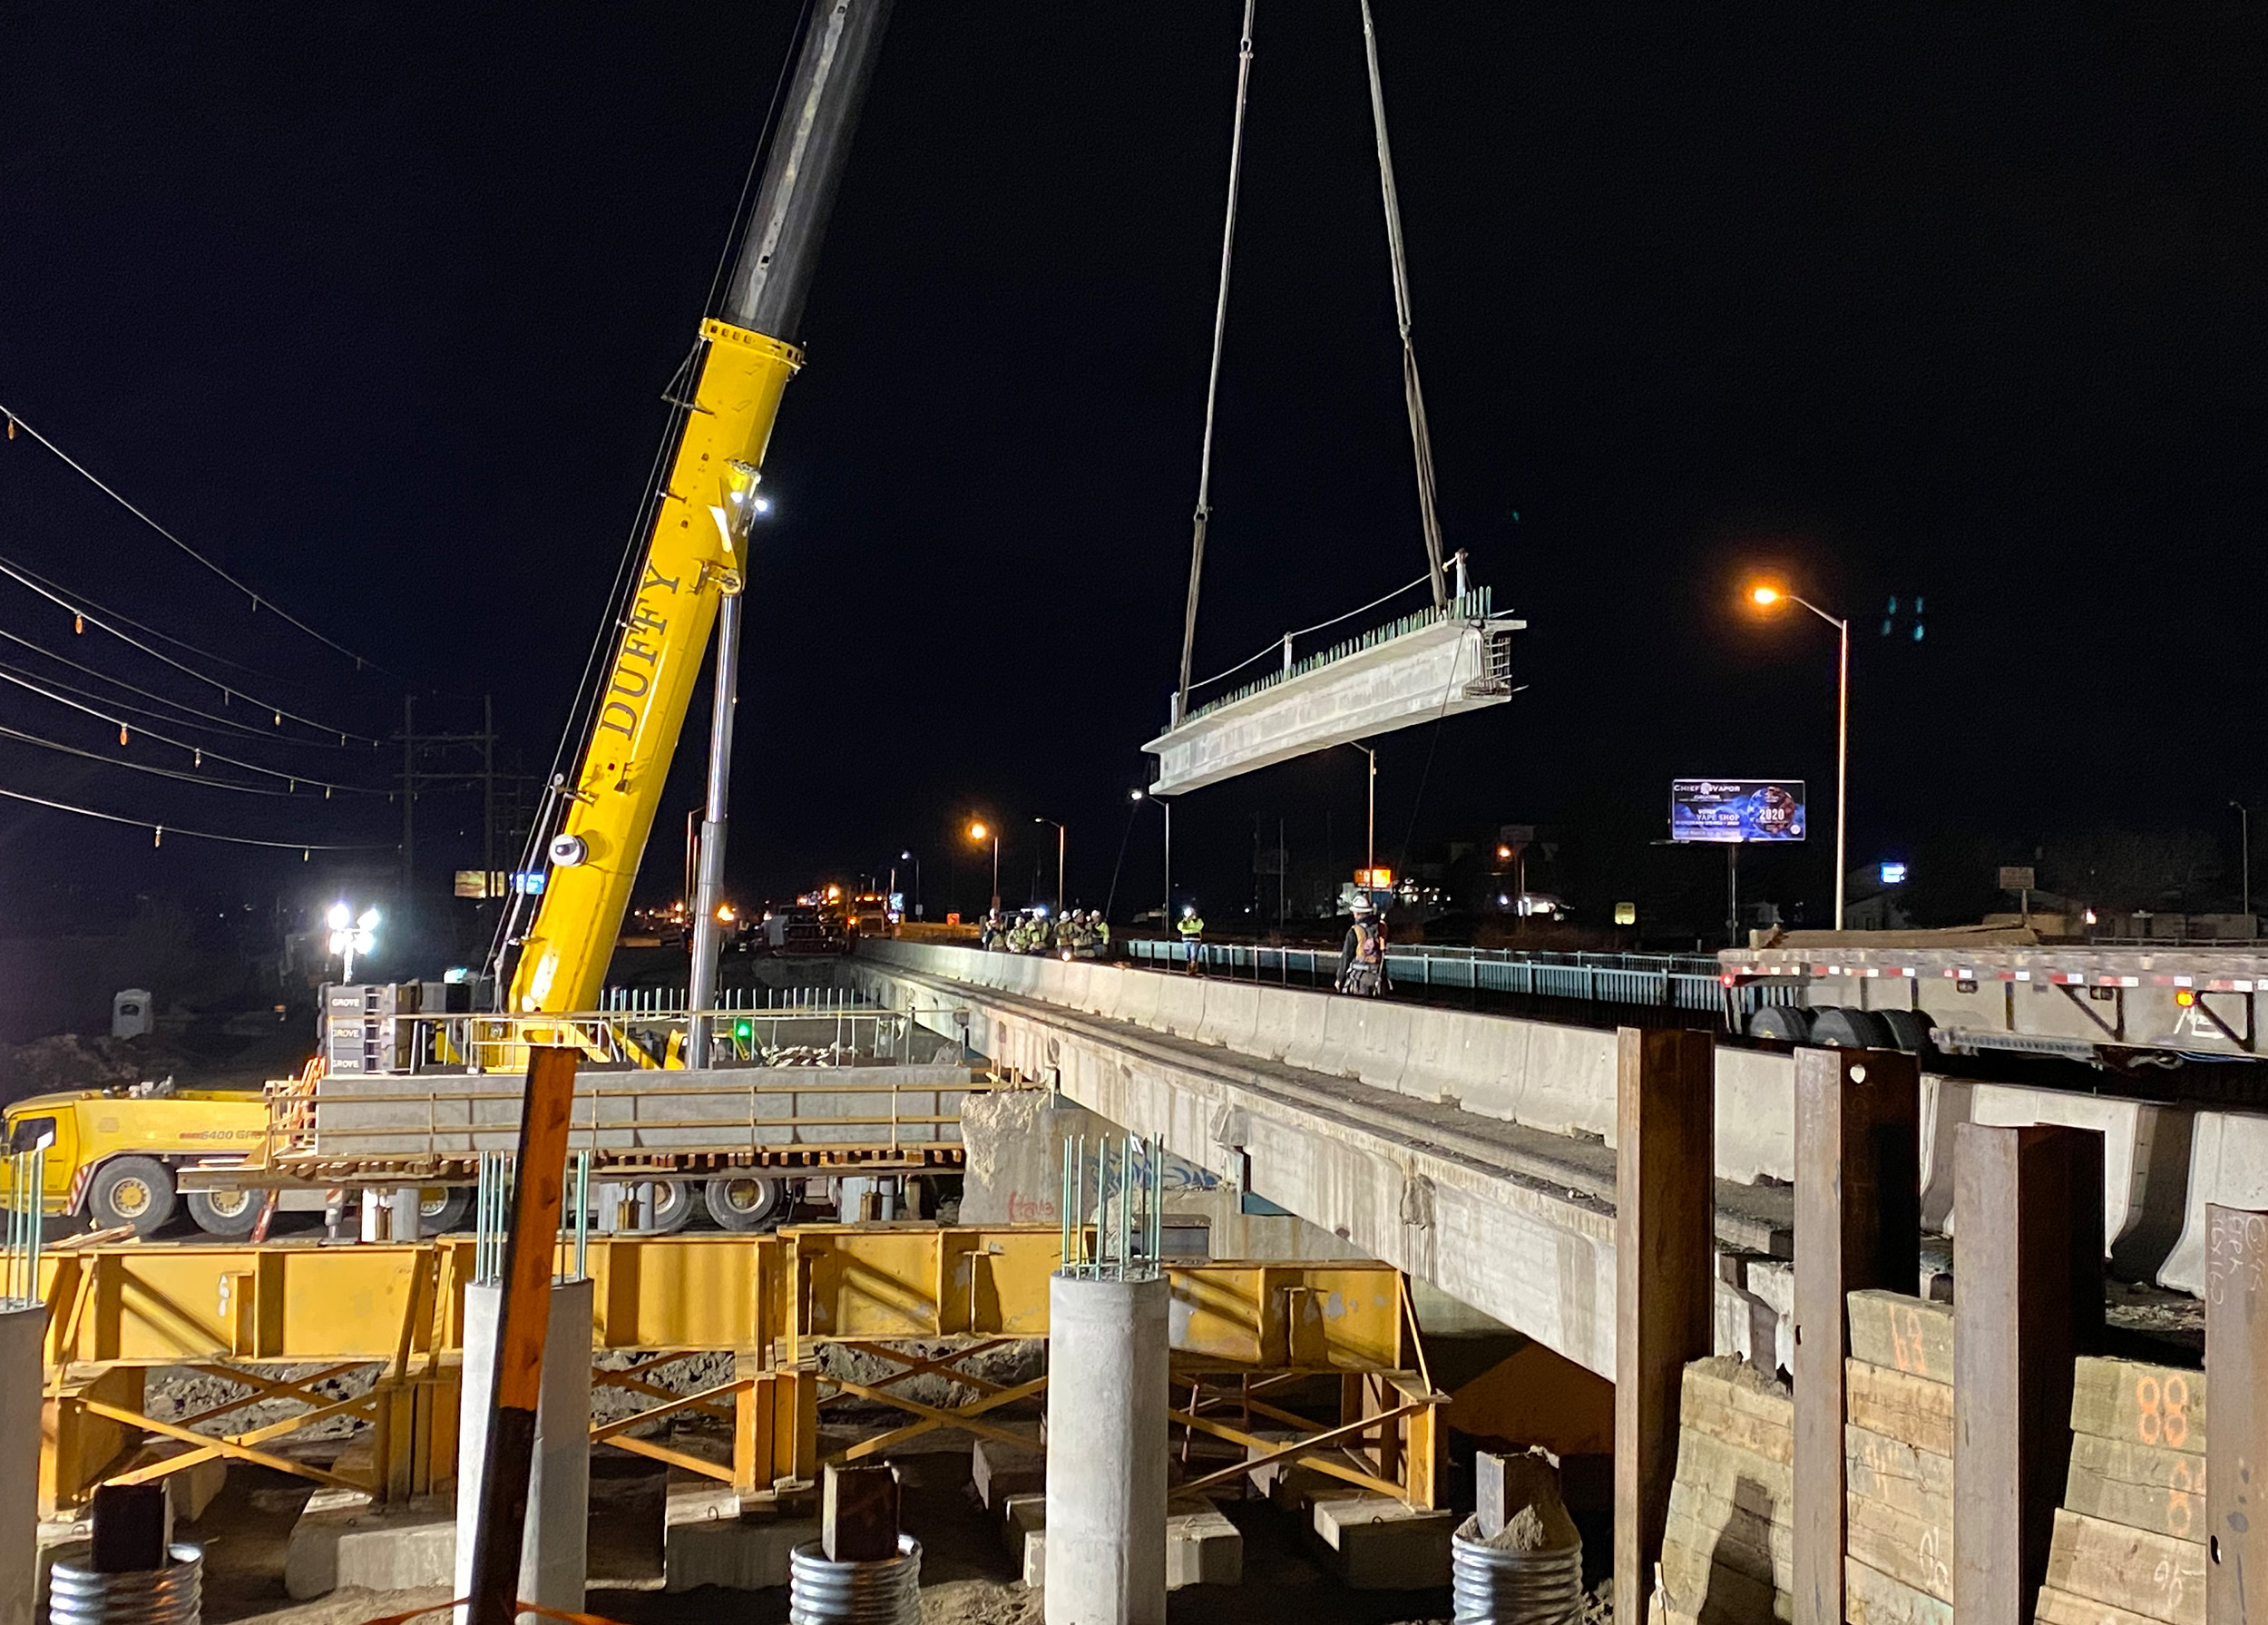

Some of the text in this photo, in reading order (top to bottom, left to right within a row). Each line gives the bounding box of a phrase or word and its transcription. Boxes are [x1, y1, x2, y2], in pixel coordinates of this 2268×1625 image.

[599, 559, 679, 741] DUFFY
[1759, 808, 1785, 821] 2020
[331, 998, 360, 1007] GROVE
[2136, 1373, 2189, 1447] 88
